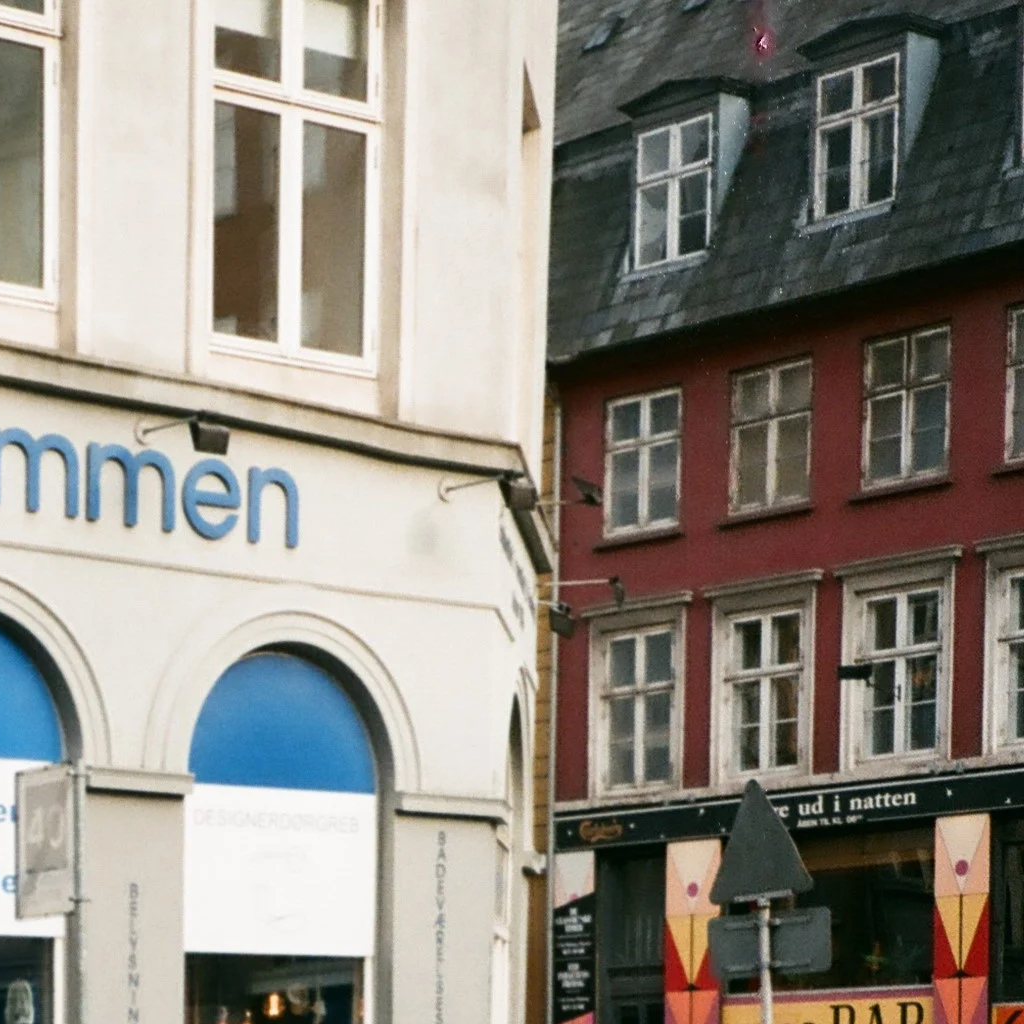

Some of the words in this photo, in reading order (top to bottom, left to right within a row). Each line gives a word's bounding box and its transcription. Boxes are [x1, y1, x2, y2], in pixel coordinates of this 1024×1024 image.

[798, 795, 824, 816] ud
[834, 795, 841, 813] i
[850, 791, 917, 811] natten
